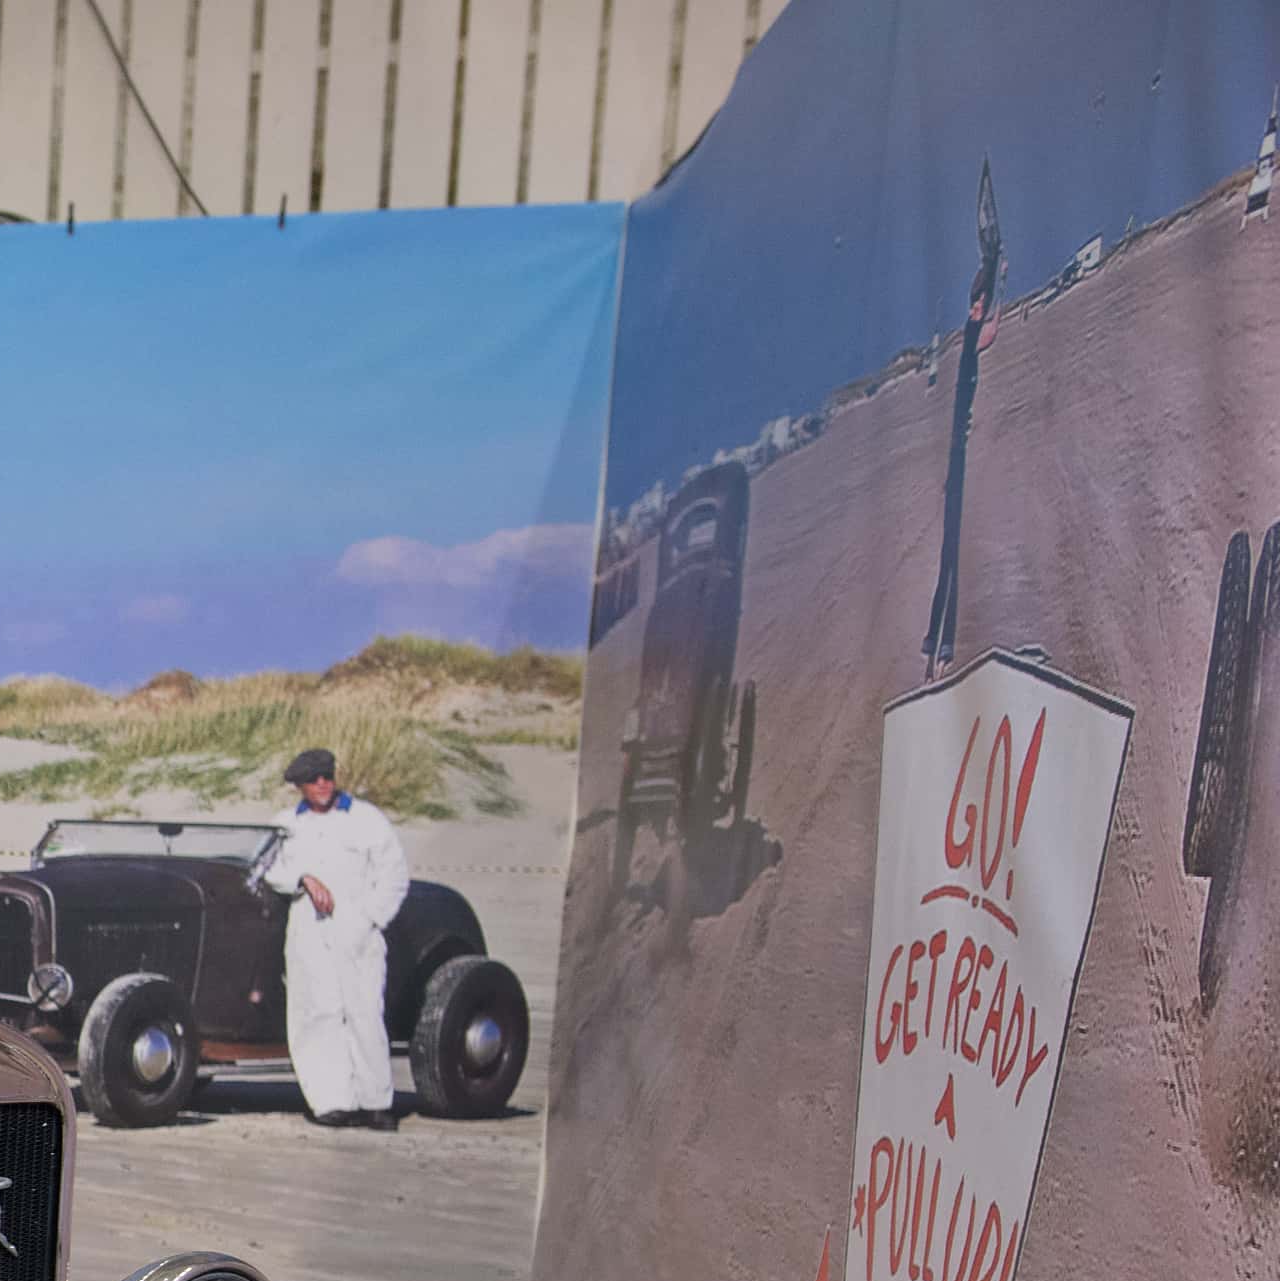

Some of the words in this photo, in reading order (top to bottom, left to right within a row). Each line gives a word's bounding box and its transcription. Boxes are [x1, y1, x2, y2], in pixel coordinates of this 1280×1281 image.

[944, 706, 1047, 902] GO!
[874, 928, 945, 1067] GET
[945, 930, 1049, 1110] READY
